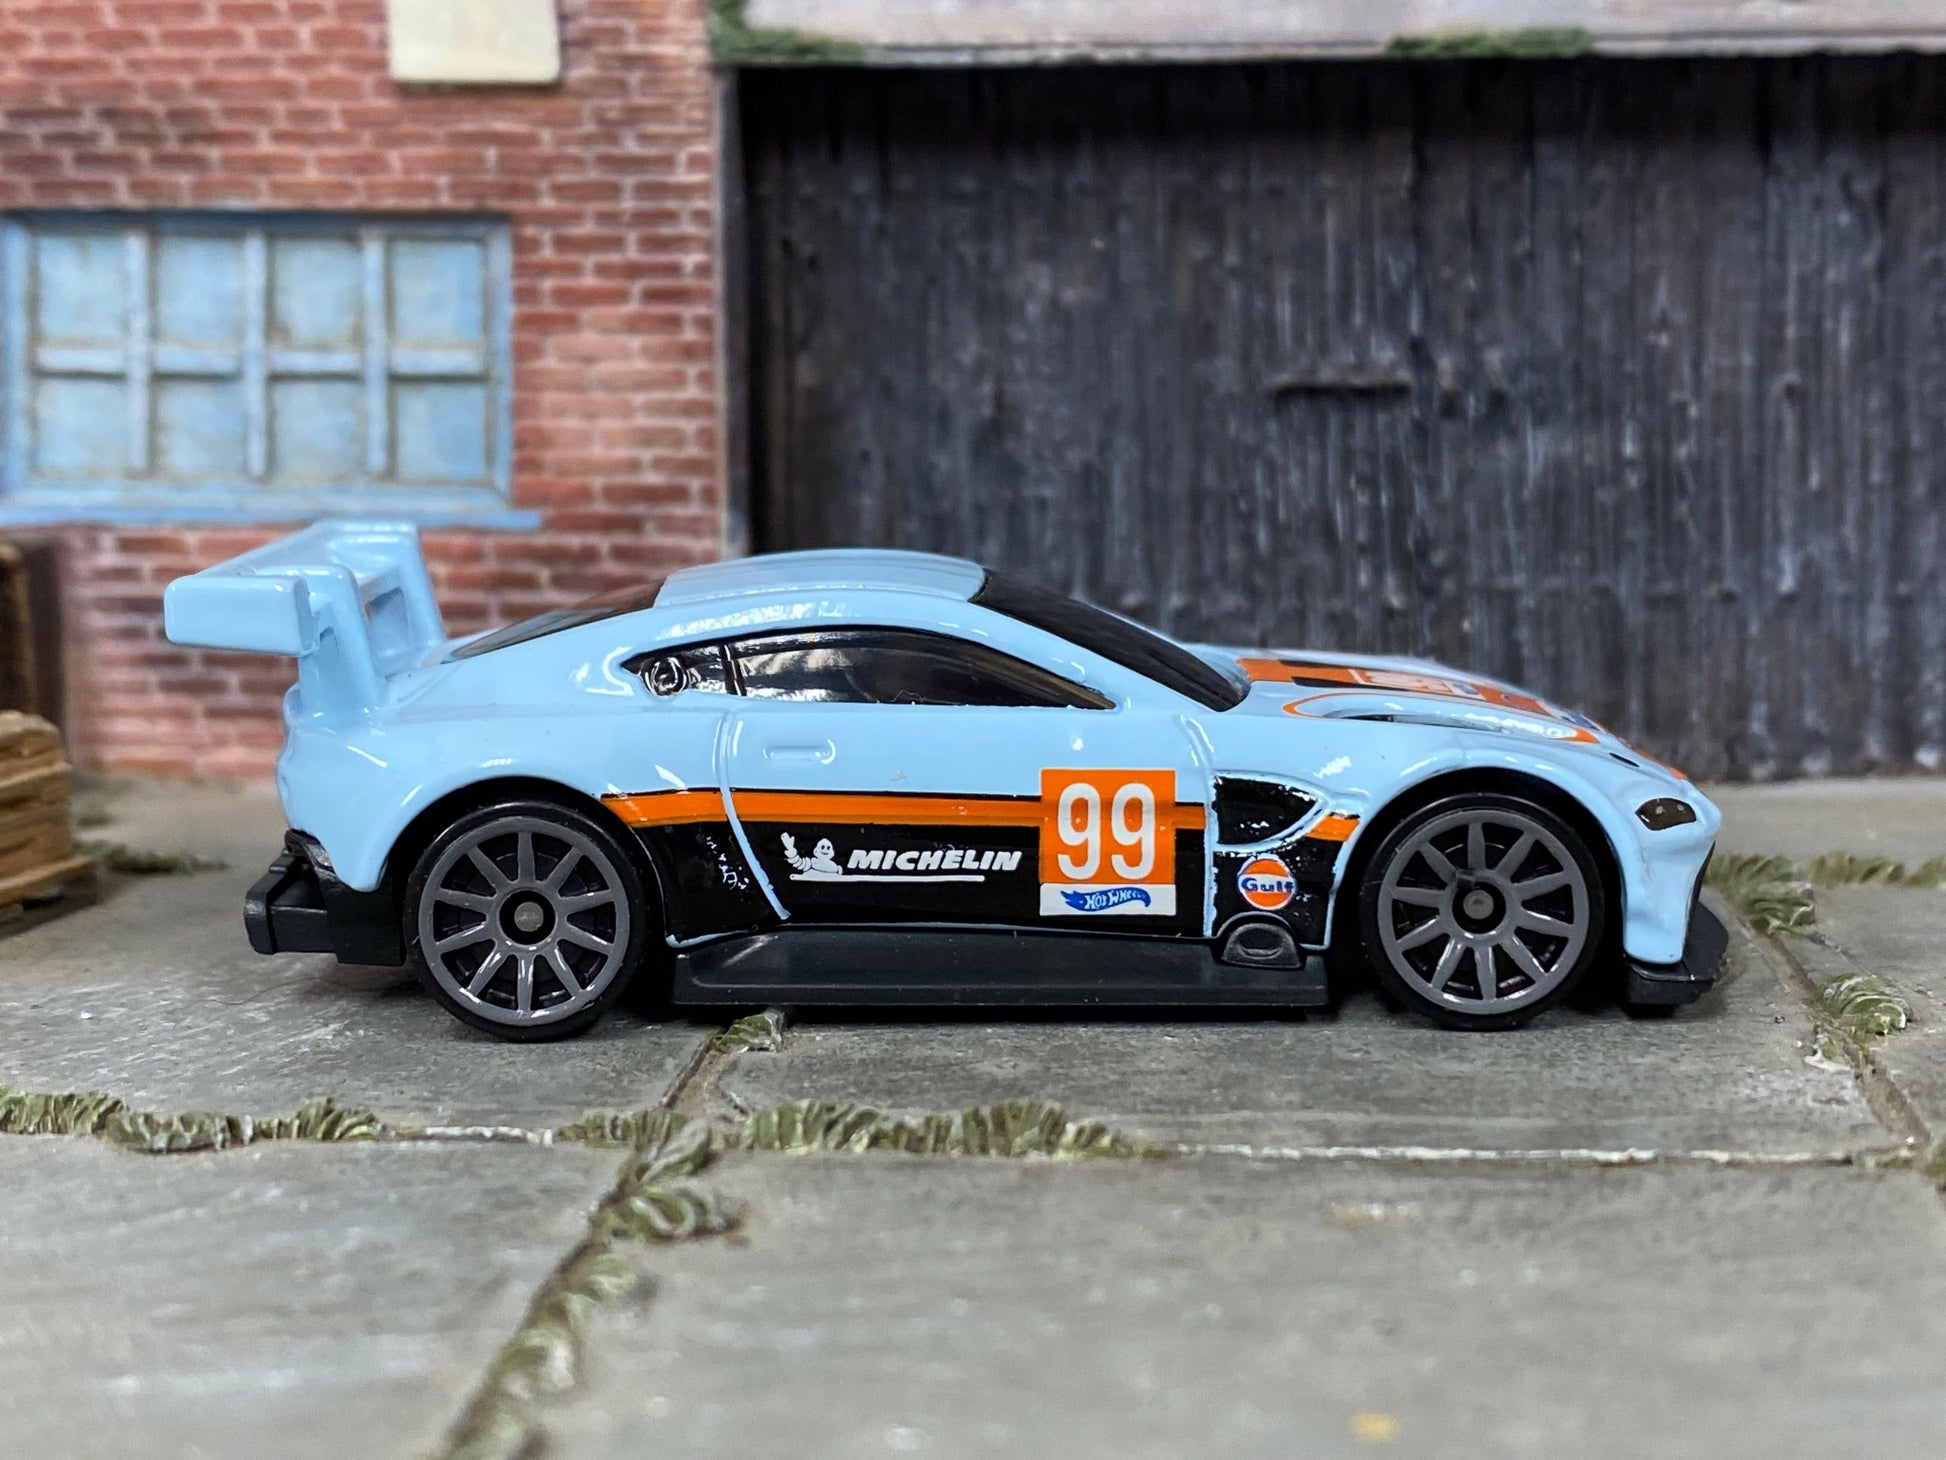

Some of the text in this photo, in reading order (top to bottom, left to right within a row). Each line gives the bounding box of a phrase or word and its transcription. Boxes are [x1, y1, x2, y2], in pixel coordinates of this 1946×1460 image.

[1057, 782, 1155, 880] 99
[847, 849, 1022, 871] MICHELIN
[1241, 877, 1294, 892] Gulf
